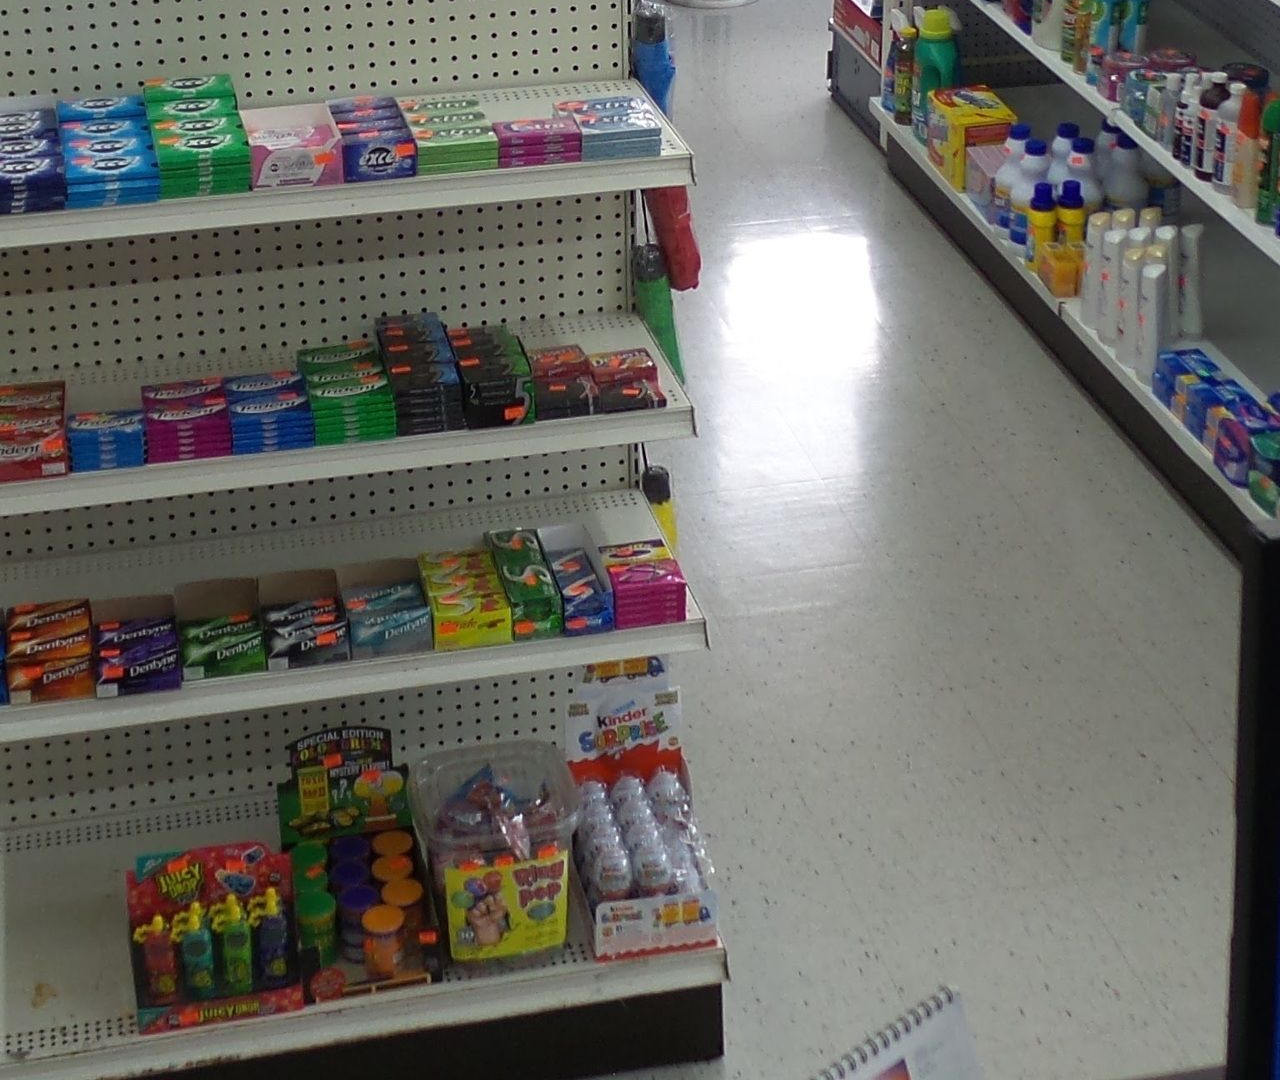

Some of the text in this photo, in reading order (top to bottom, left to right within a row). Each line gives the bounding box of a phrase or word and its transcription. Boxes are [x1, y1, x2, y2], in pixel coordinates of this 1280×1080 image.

[25, 606, 86, 629] Dentyne
[385, 614, 430, 641] Dentyne
[26, 633, 87, 655] Dentyne
[113, 623, 172, 644] Dentyne
[217, 635, 262, 660] Dentyne
[42, 660, 90, 685] Dentyne
[129, 653, 177, 677] Dentyne
[596, 707, 648, 729] Kinder
[297, 728, 384, 752] SPECIAL EDITION
[159, 863, 201, 894] JUICY
